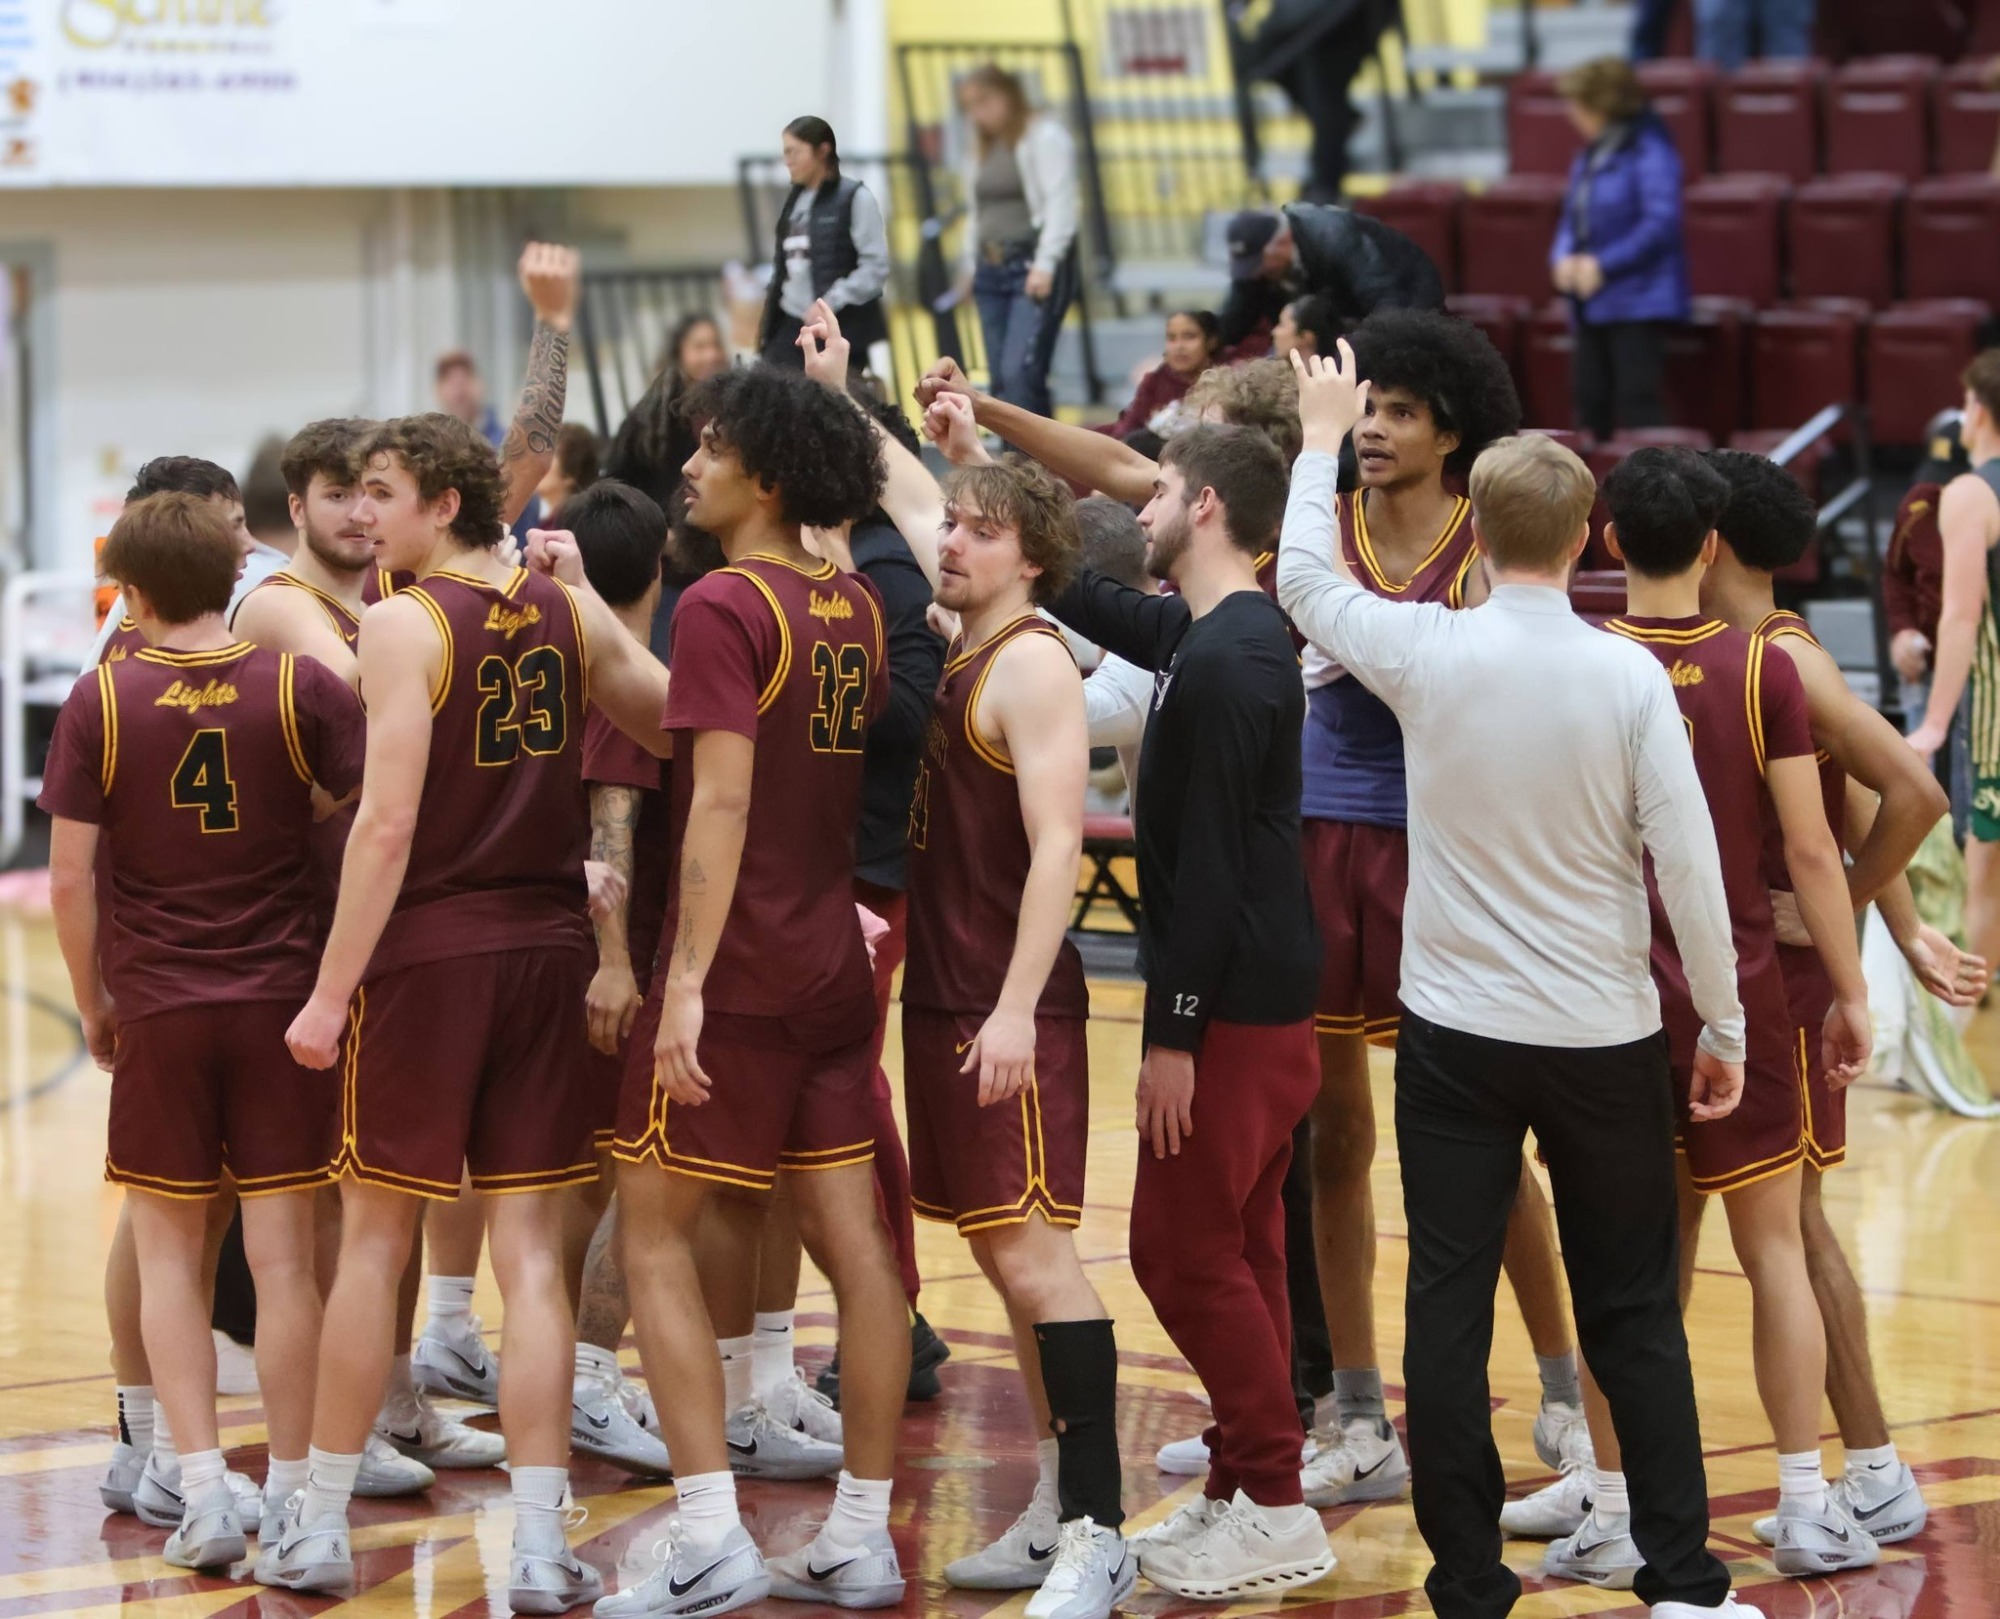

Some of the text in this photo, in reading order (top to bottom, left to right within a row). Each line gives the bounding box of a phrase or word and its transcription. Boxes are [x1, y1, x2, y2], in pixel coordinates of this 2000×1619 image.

[527, 336, 569, 454] Hansen
[808, 589, 854, 627] Lights
[154, 678, 239, 714] Lights
[475, 645, 567, 766] 23
[810, 640, 864, 754] 32
[170, 727, 239, 834] 4
[1172, 993, 1199, 1017] 12
